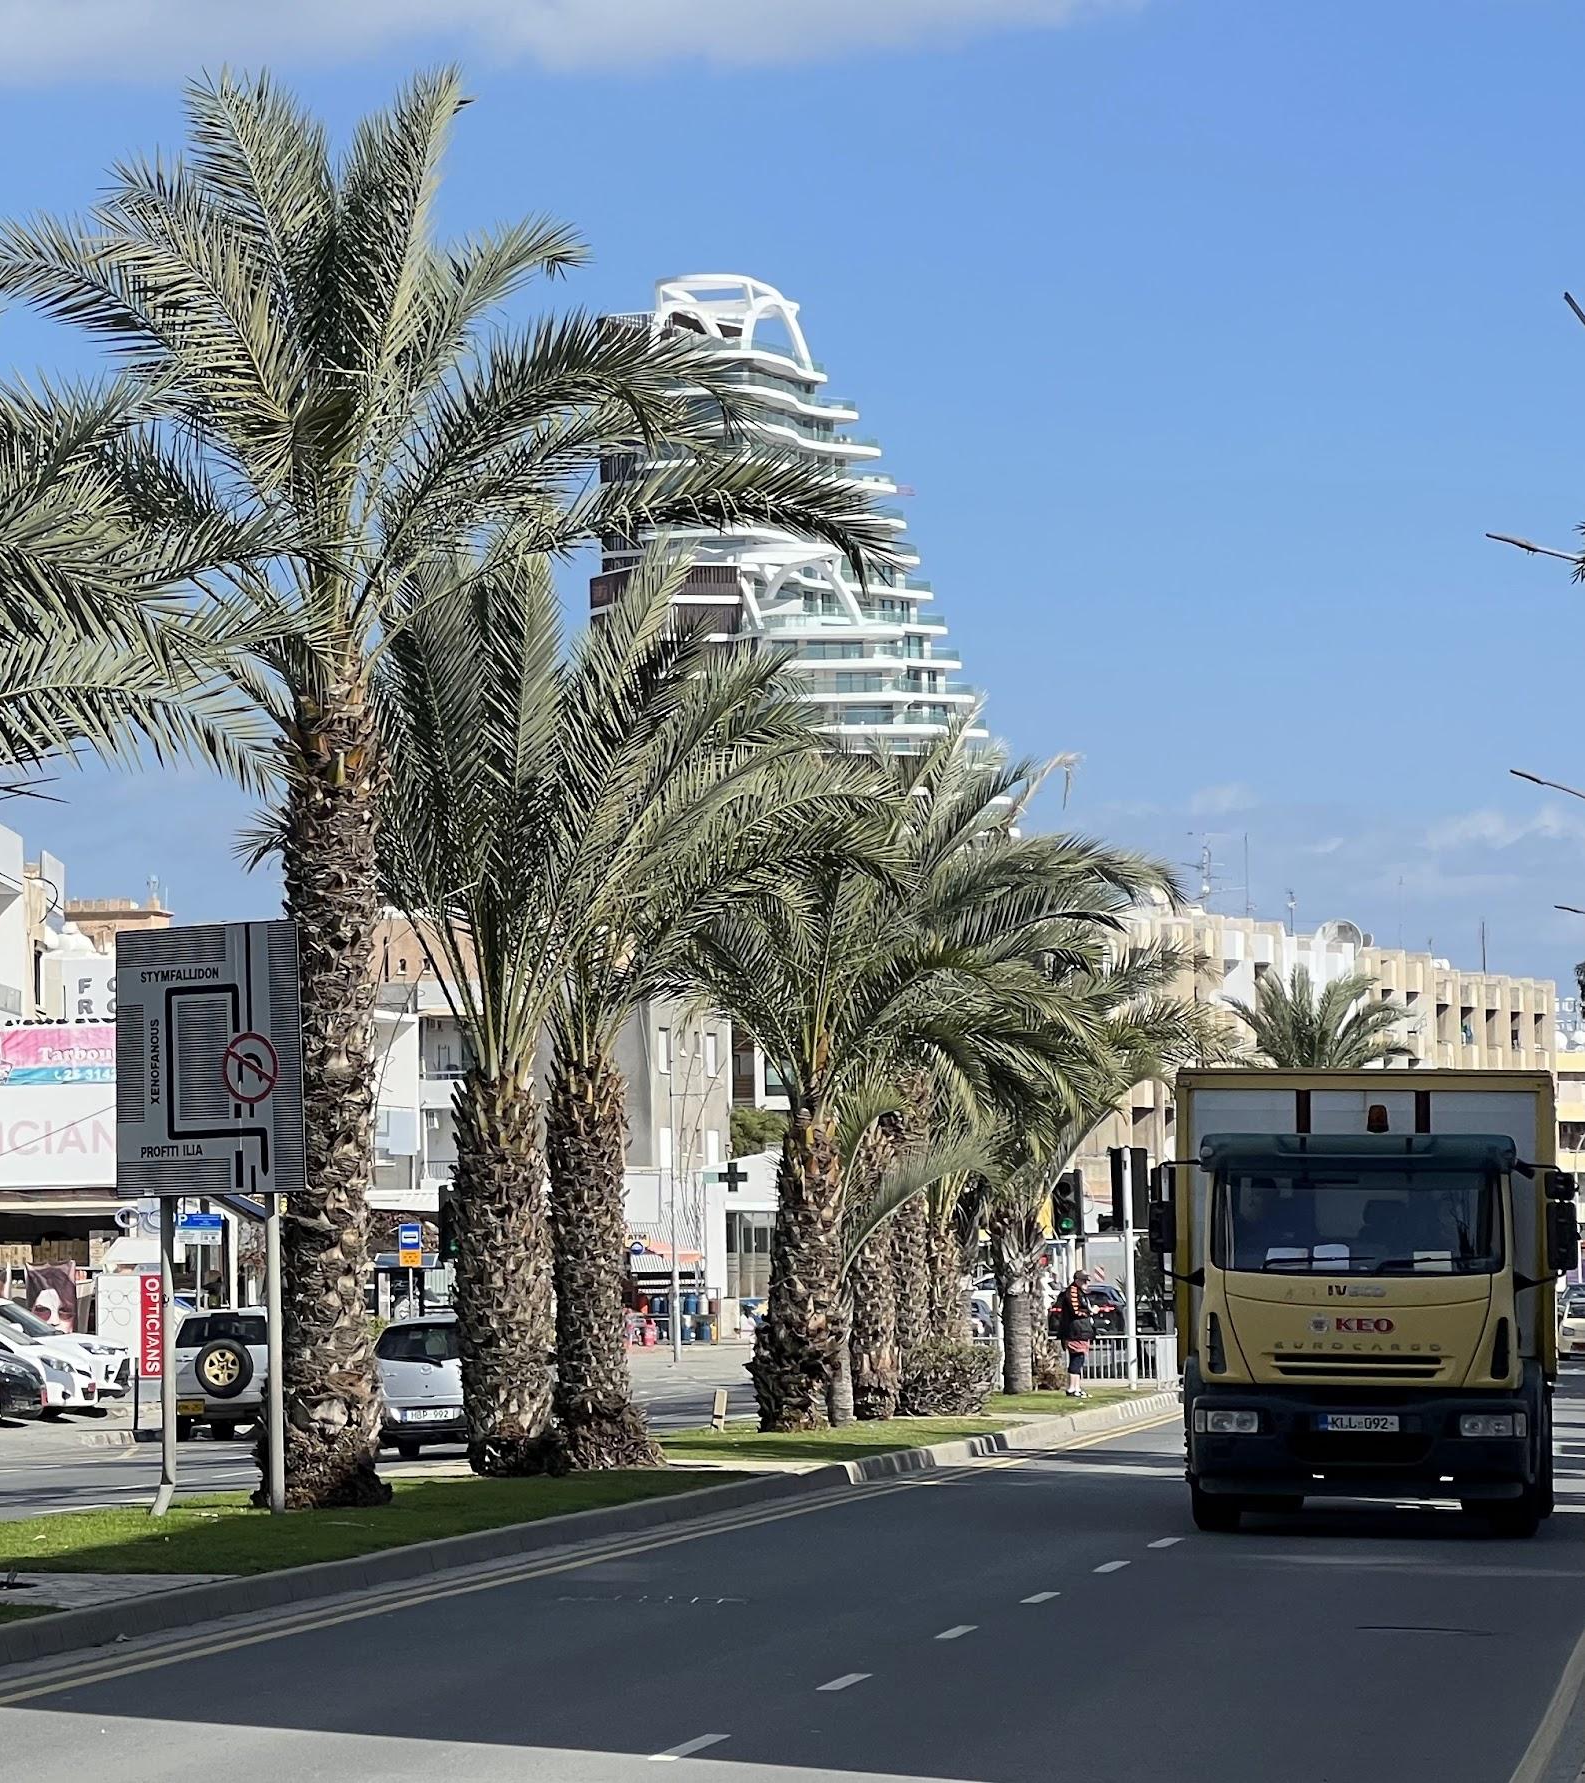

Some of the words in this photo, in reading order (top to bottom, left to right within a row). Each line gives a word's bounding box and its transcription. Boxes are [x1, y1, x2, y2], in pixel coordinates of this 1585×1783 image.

[140, 967, 219, 983] STYMFALLIDON
[150, 1018, 160, 1105] XENOFANOUS
[140, 1146, 179, 1159] PROFITI
[182, 1144, 203, 1157] ILIA
[145, 1278, 160, 1373] OPTICIANS
[1335, 1318, 1396, 1334] KEO
[1274, 1341, 1442, 1352] EUROCARGO
[1330, 1417, 1357, 1430] KLL
[1364, 1417, 1389, 1430] 092
